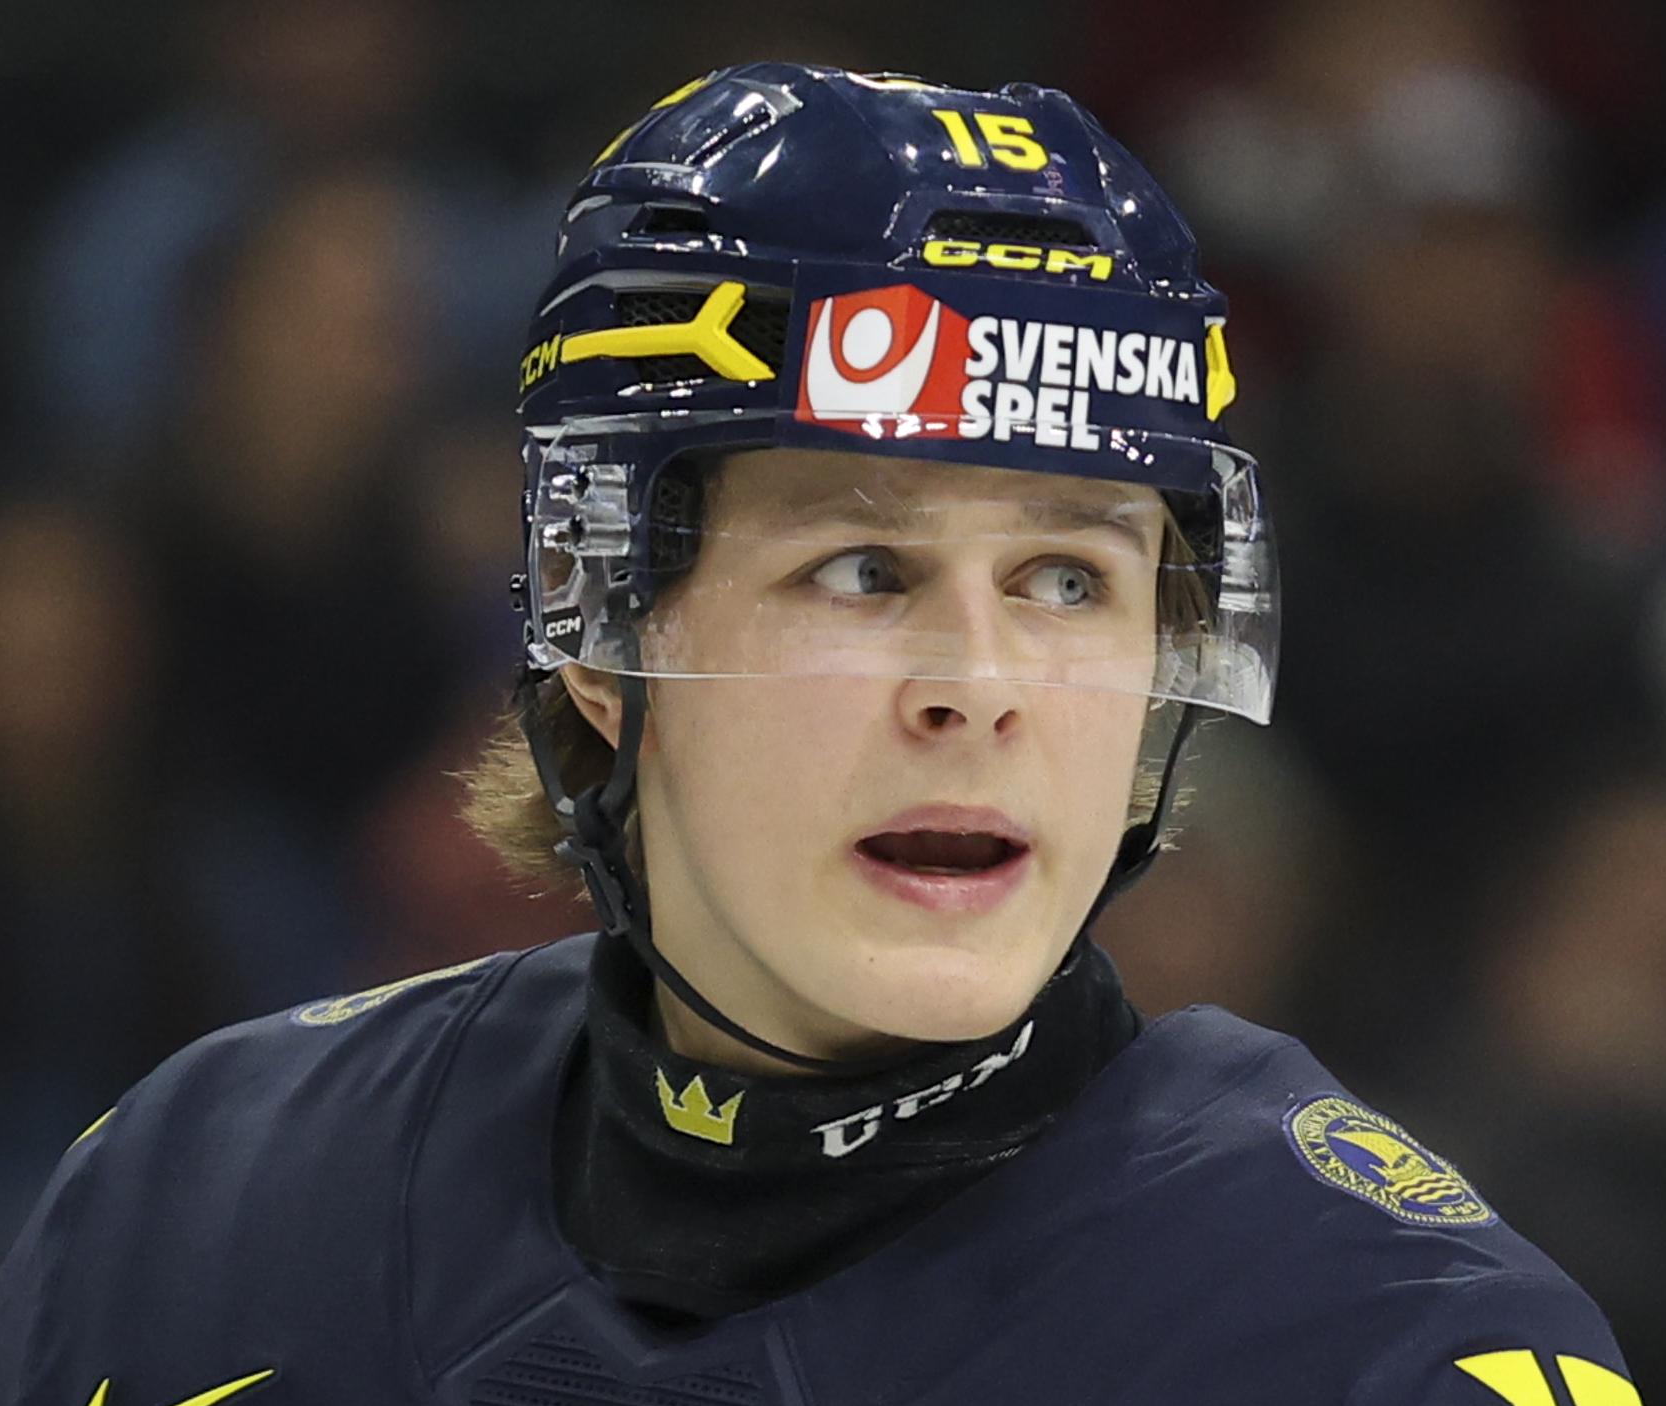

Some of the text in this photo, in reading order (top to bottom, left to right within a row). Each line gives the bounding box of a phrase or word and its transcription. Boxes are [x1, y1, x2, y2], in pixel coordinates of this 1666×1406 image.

[932, 109, 1051, 172] 15
[922, 240, 1114, 281] CCM
[965, 315, 1201, 405] SVENSKA
[959, 380, 1101, 451] SPEL
[545, 615, 582, 638] CCM
